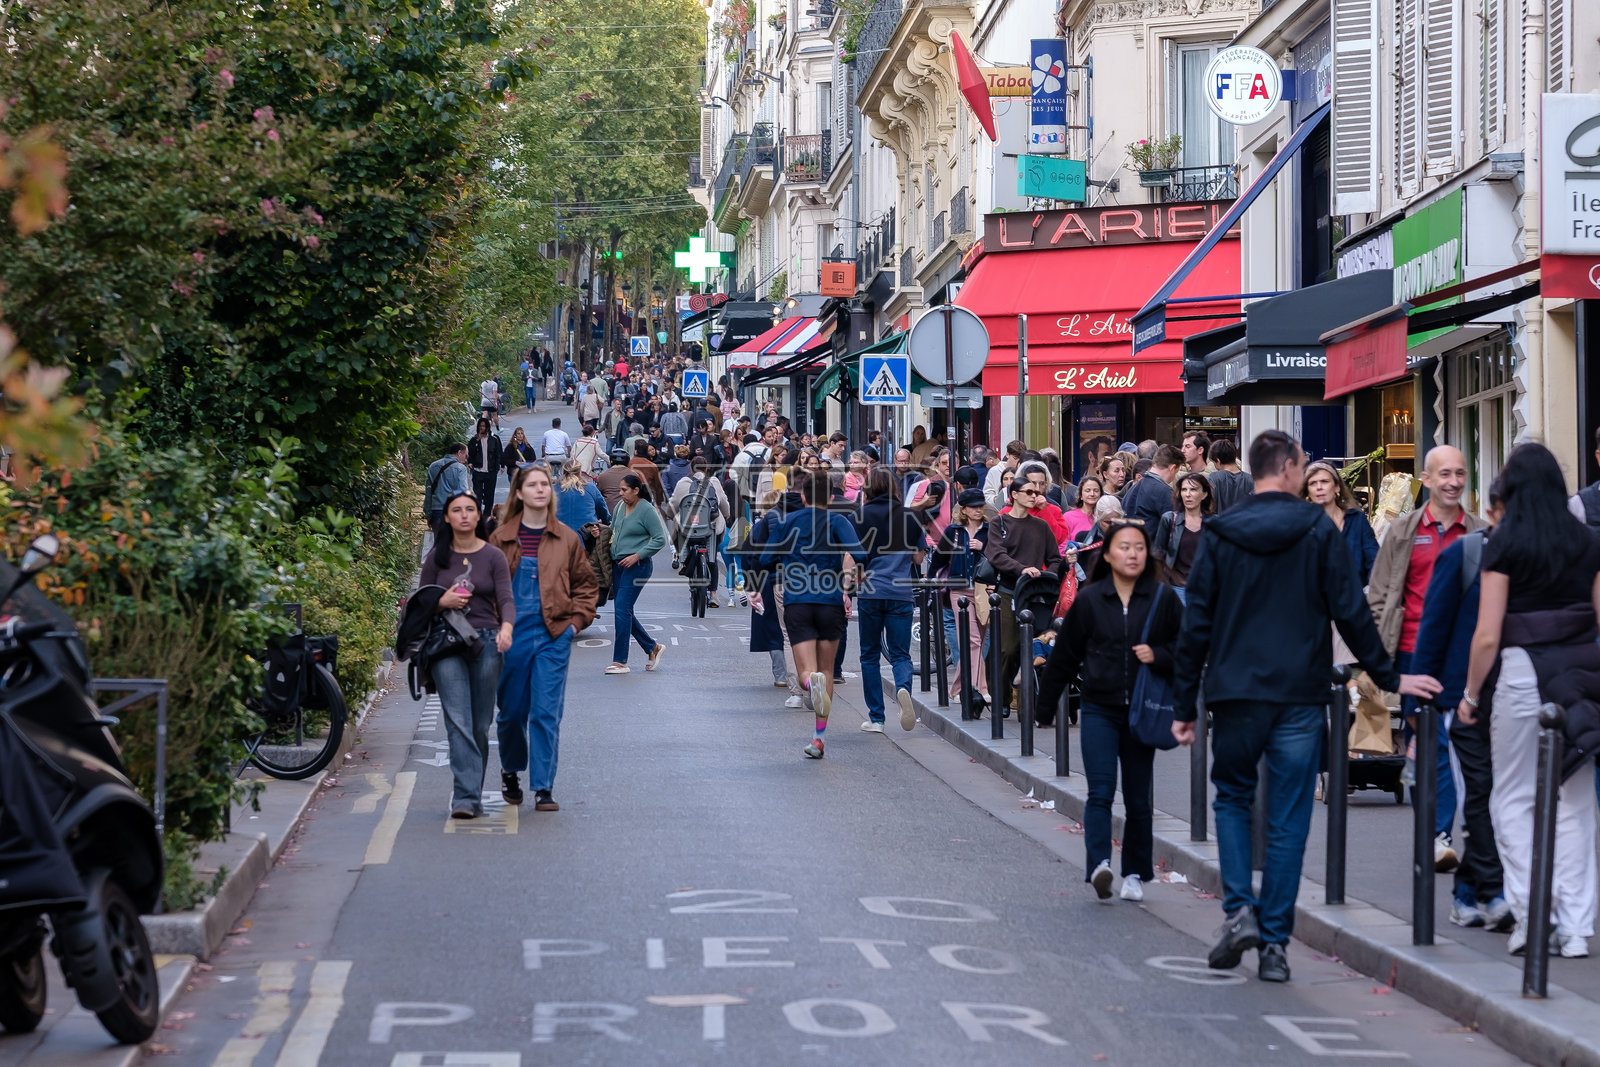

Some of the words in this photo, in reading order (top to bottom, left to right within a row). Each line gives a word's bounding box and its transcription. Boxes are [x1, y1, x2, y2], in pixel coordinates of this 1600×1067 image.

[1221, 49, 1264, 60] FÉDÉRATION
[1224, 54, 1262, 65] FRANÇAISE
[1216, 73, 1270, 100] FFA
[1032, 132, 1066, 145] LOTO
[1054, 366, 1138, 390] L'Ariel
